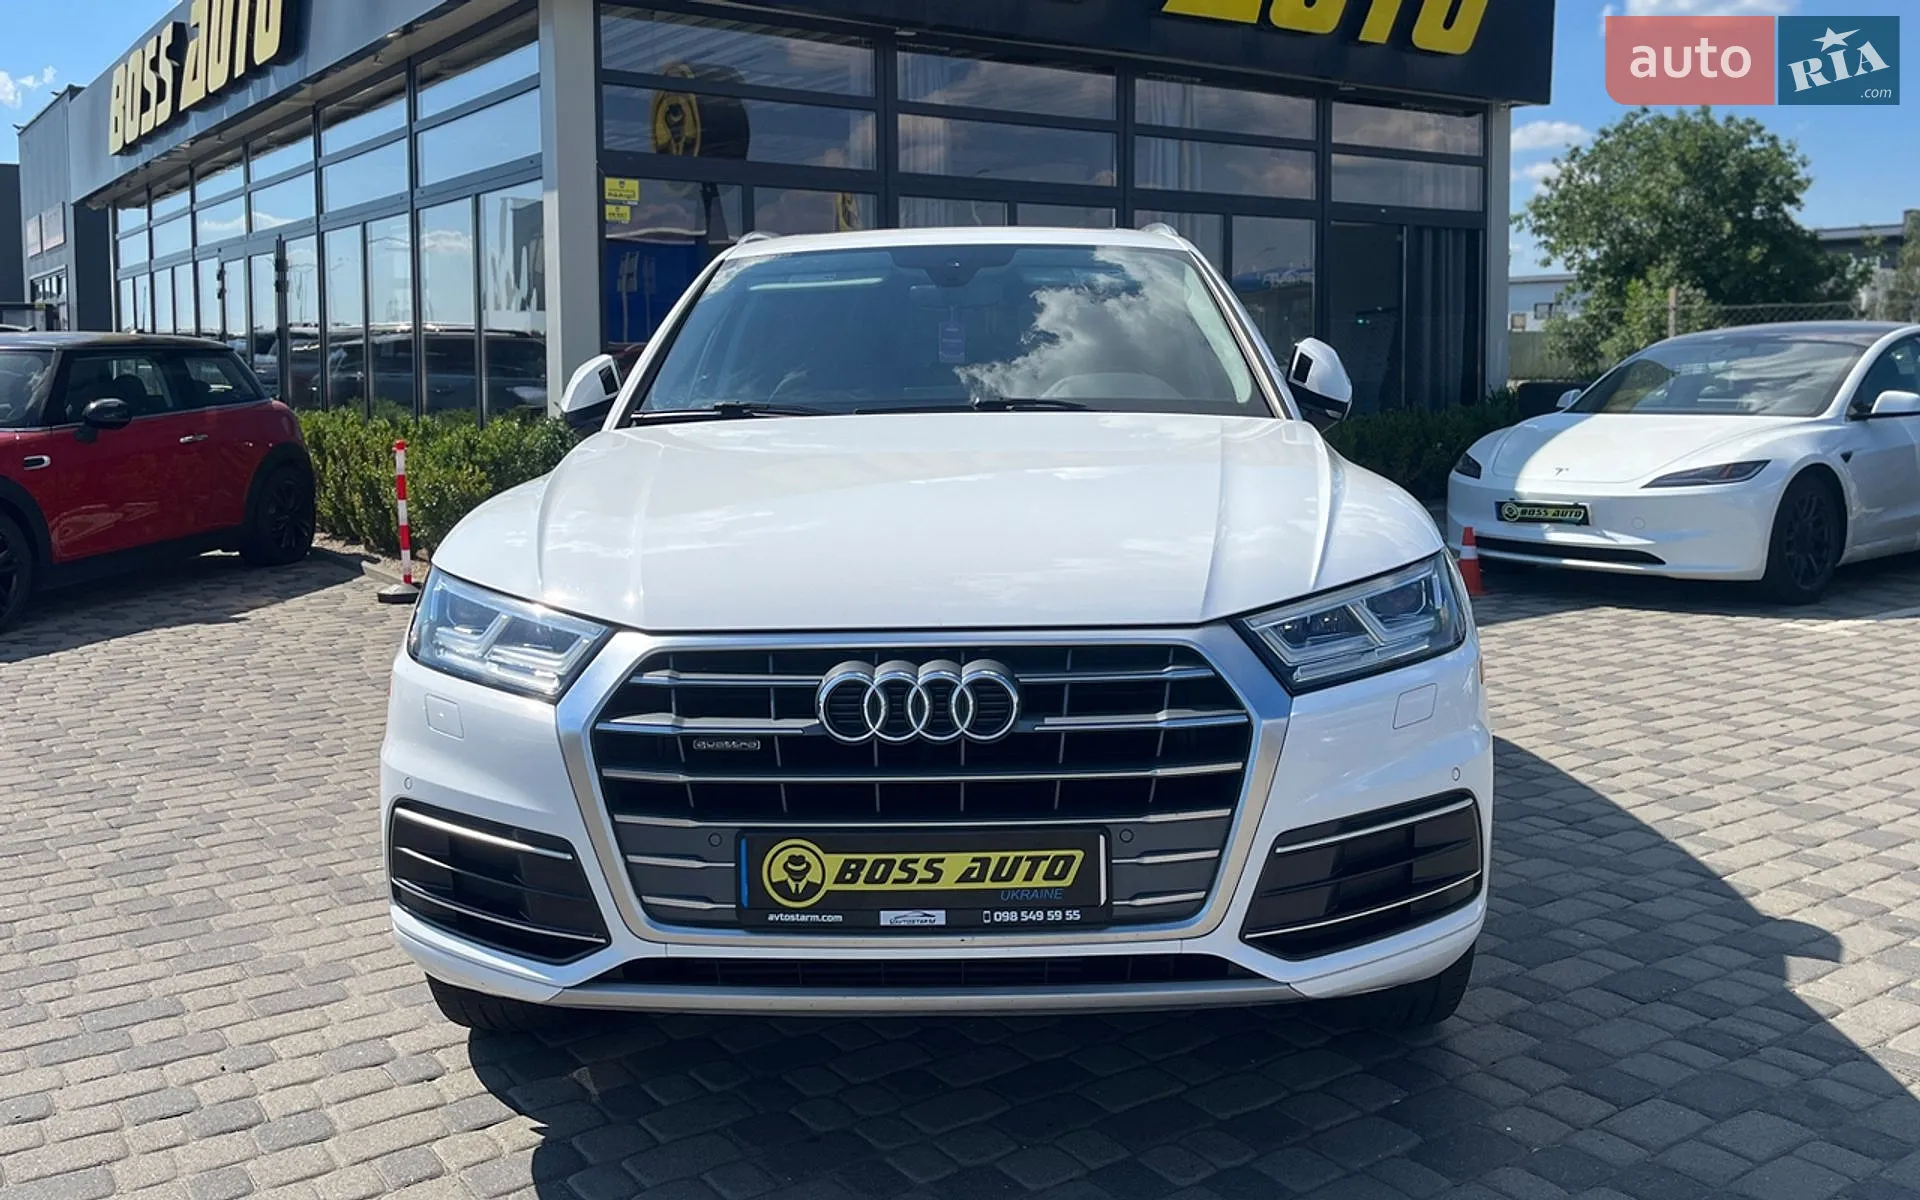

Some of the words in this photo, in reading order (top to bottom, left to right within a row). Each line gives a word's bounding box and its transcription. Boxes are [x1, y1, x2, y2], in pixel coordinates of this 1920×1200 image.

[108, 20, 175, 156] BOSS
[833, 857, 946, 885] BOSS
[954, 854, 1077, 884] AUTO
[1000, 888, 1065, 901] UKRAINE
[767, 912, 843, 923] avtostarm.com
[993, 910, 1019, 922] 098
[1020, 910, 1044, 921] 549
[1046, 910, 1063, 921] 59
[1064, 909, 1081, 921] 55
